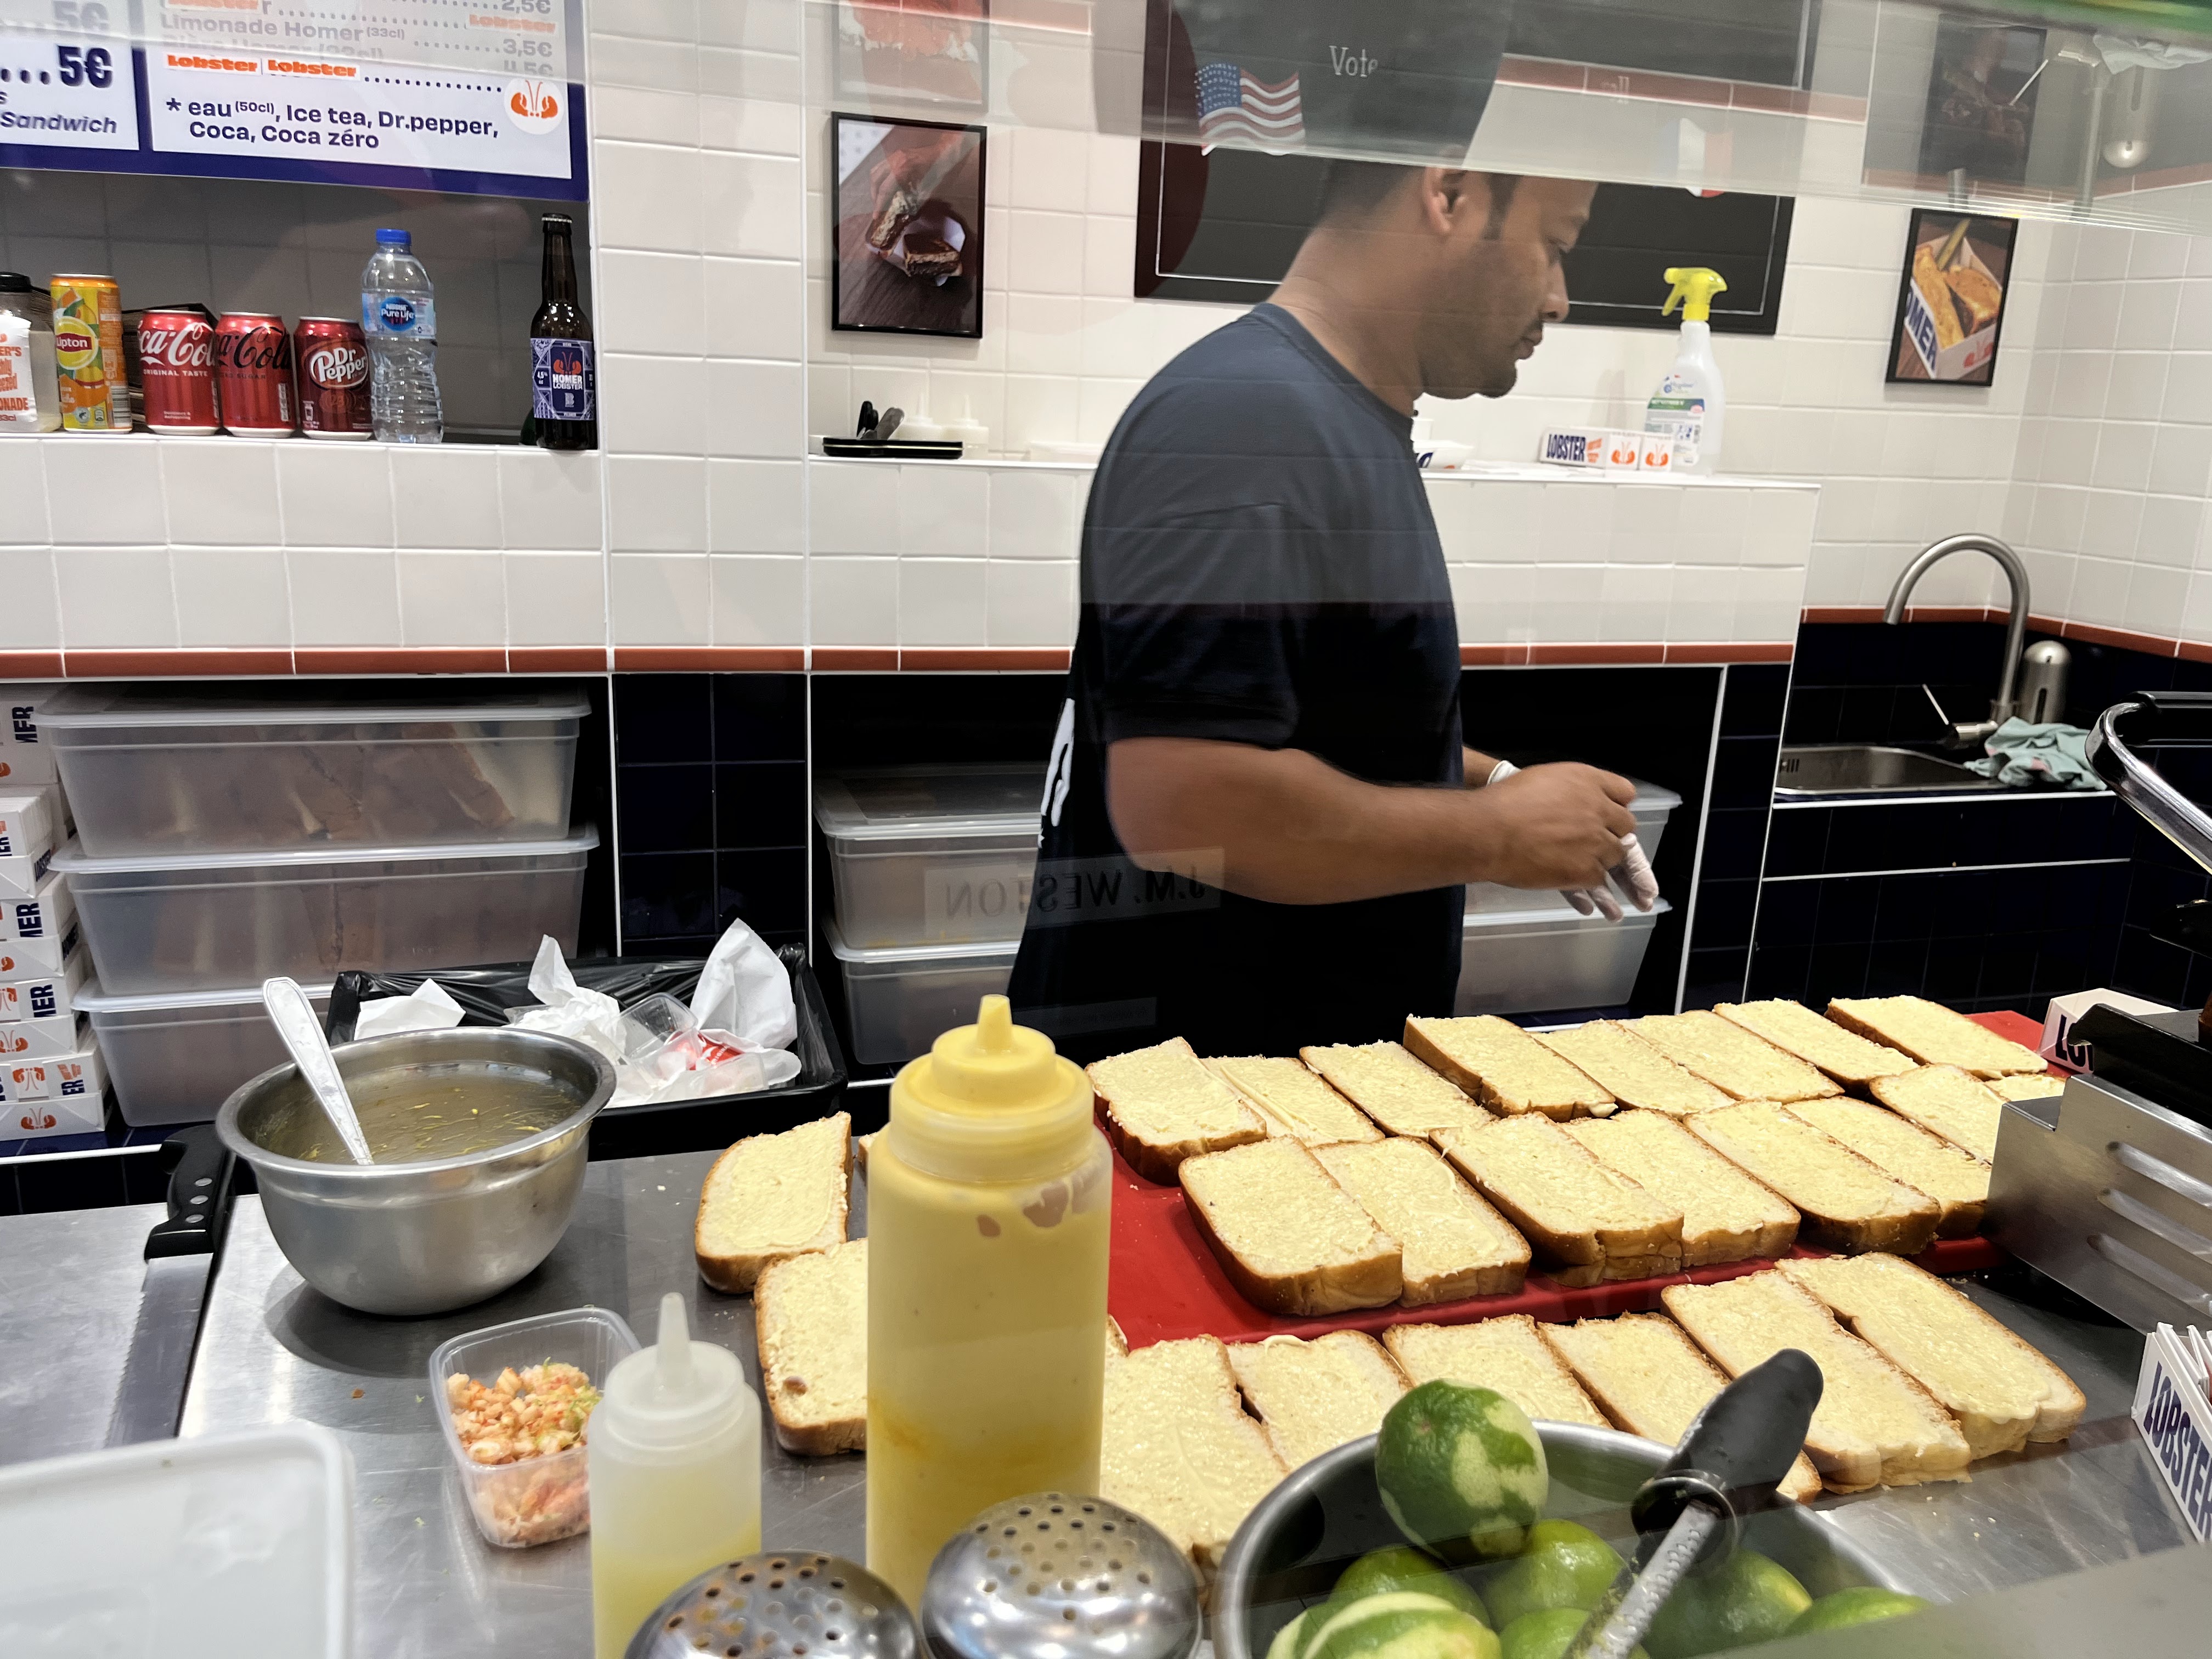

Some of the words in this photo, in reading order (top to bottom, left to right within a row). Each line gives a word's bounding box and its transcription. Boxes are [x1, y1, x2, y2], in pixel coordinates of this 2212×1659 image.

[160, 13, 278, 36] Limonade
[284, 21, 364, 41] Homer
[503, 38, 552, 57] 3,5€
[57, 45, 112, 88] 5€
[167, 54, 258, 72] Lobster
[267, 59, 357, 77] Lobster
[0, 111, 117, 133] Sandwich
[286, 104, 322, 122] Ice
[328, 108, 373, 129] tea,
[189, 121, 256, 143] Coca,
[261, 125, 321, 145] Coca
[328, 128, 379, 148] zéro
[310, 351, 366, 383] Pepper
[334, 347, 357, 365] Dr
[552, 374, 583, 385] HOMER
[1546, 433, 1586, 462] LOBSTER
